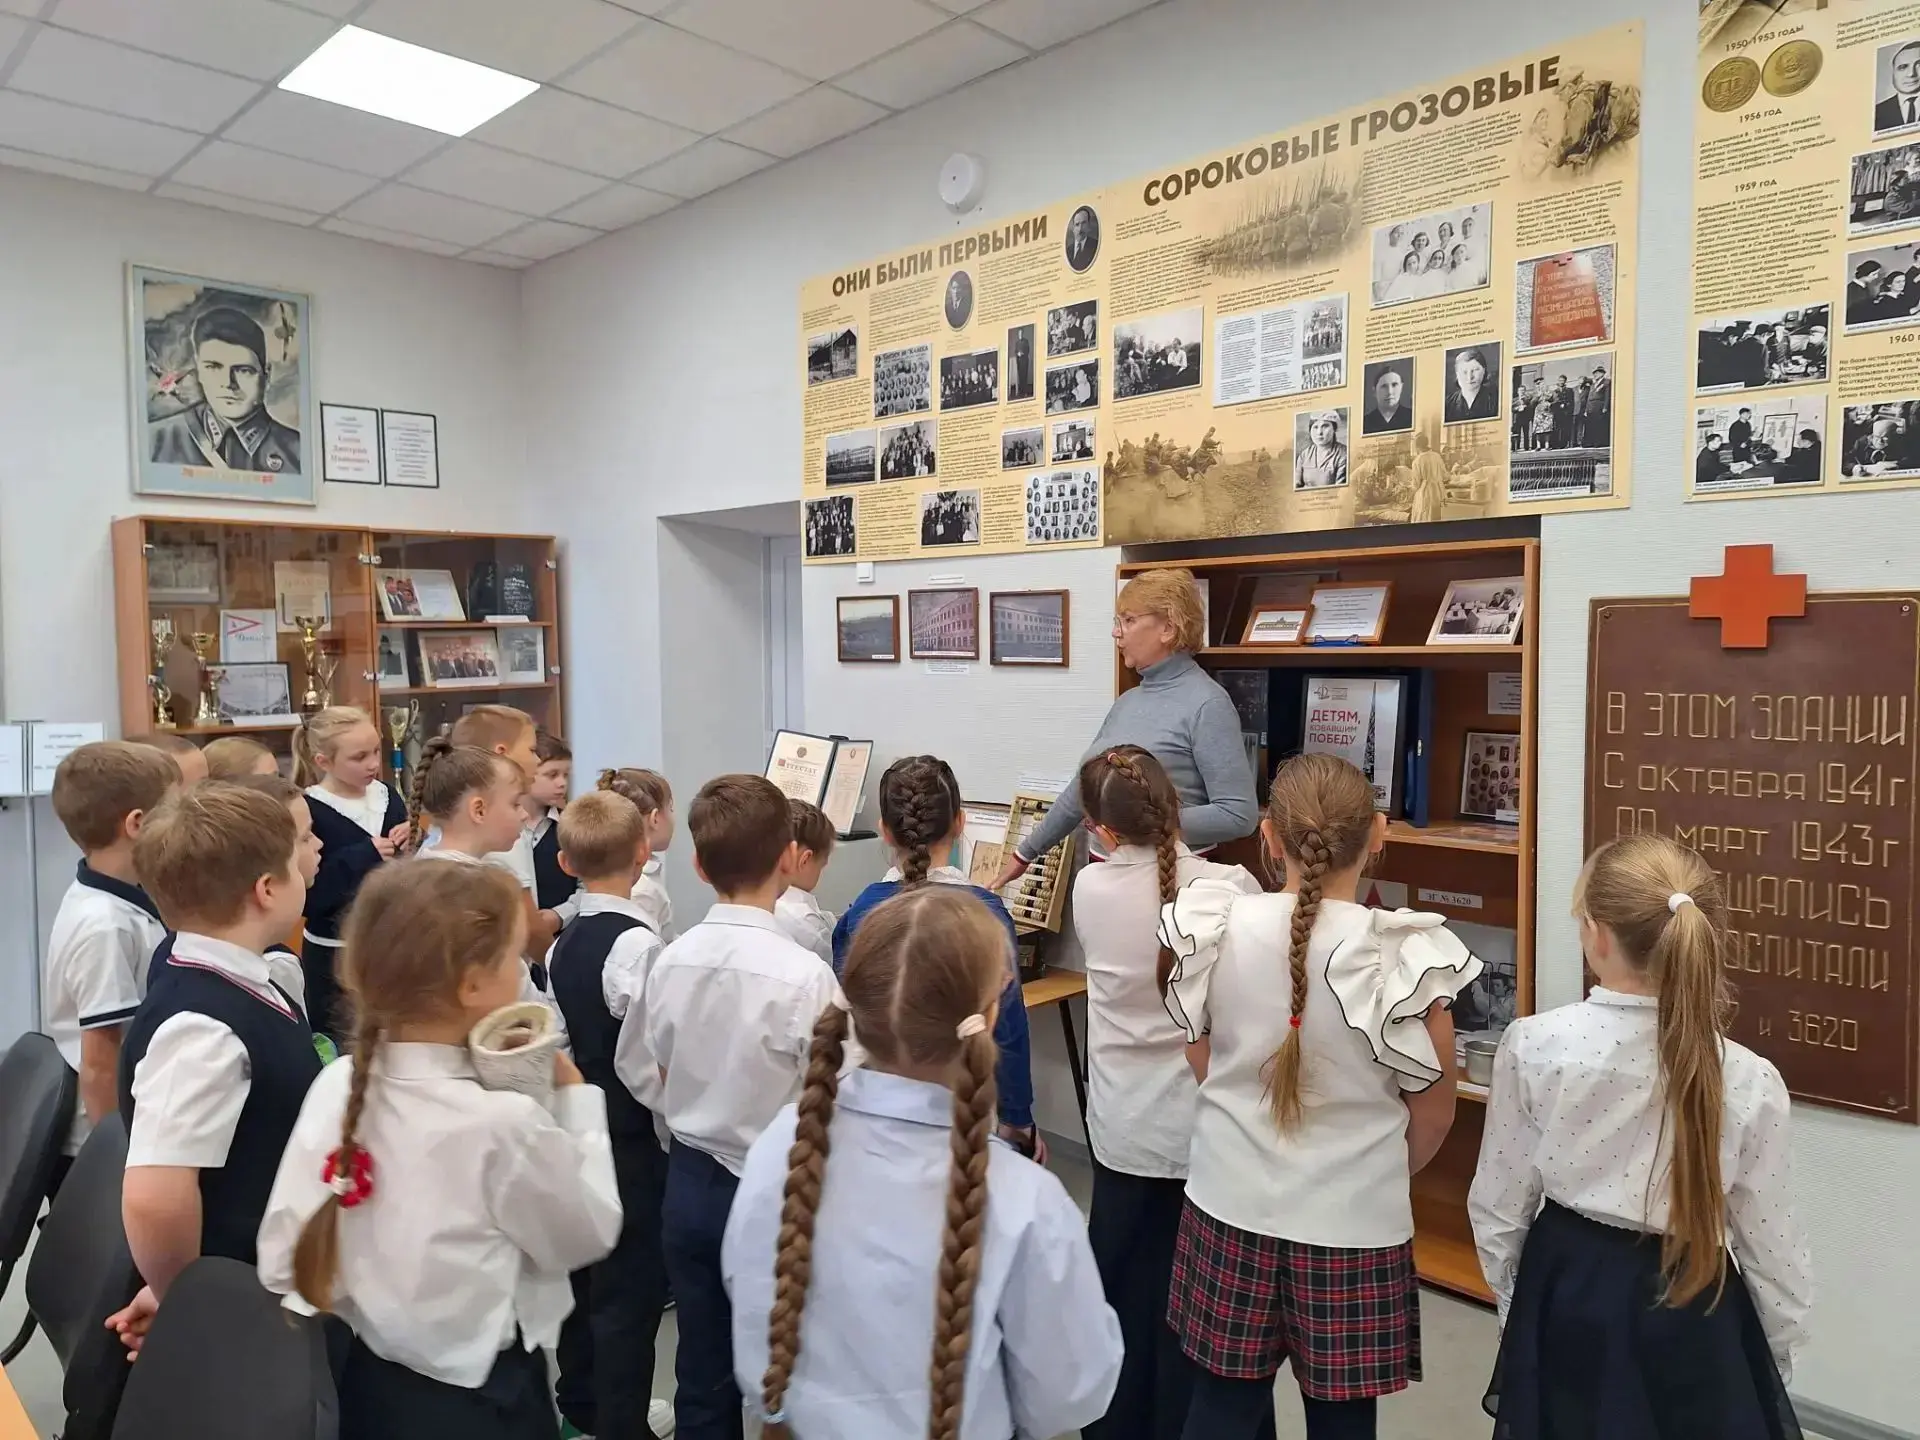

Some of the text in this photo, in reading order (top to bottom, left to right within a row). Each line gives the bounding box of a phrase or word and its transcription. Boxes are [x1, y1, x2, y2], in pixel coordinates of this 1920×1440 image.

[1725, 25, 1804, 52] 1950-1953 годы
[1740, 108, 1782, 123] 1956 год
[1144, 123, 1340, 206] СОРОКОВЫЕ
[1350, 55, 1560, 146] ГРОЗОВЫЕ
[1735, 180, 1777, 192] 1959 год
[832, 215, 1048, 297] ОНИ БЫЛИ ПЕРВЫМИ
[1890, 334, 1914, 344] 1960
[1310, 710, 1360, 724] ДЕТЯМ,
[1310, 724, 1357, 733] КОВАВШИМ
[1607, 692, 1906, 745] В ЭТОМ ЗДАНИИ
[1309, 733, 1356, 746] ПОБЕДУ
[1604, 752, 1624, 788] С
[1638, 766, 1806, 800] ОКТЯБРЯ
[1675, 824, 1770, 856] МАРТ
[1452, 896, 1471, 905] 3620
[1712, 871, 1890, 930] ЩАЛИСЬ
[1716, 929, 1889, 992] ОСПИТАЛИ
[1788, 1010, 1858, 1052] 3620
